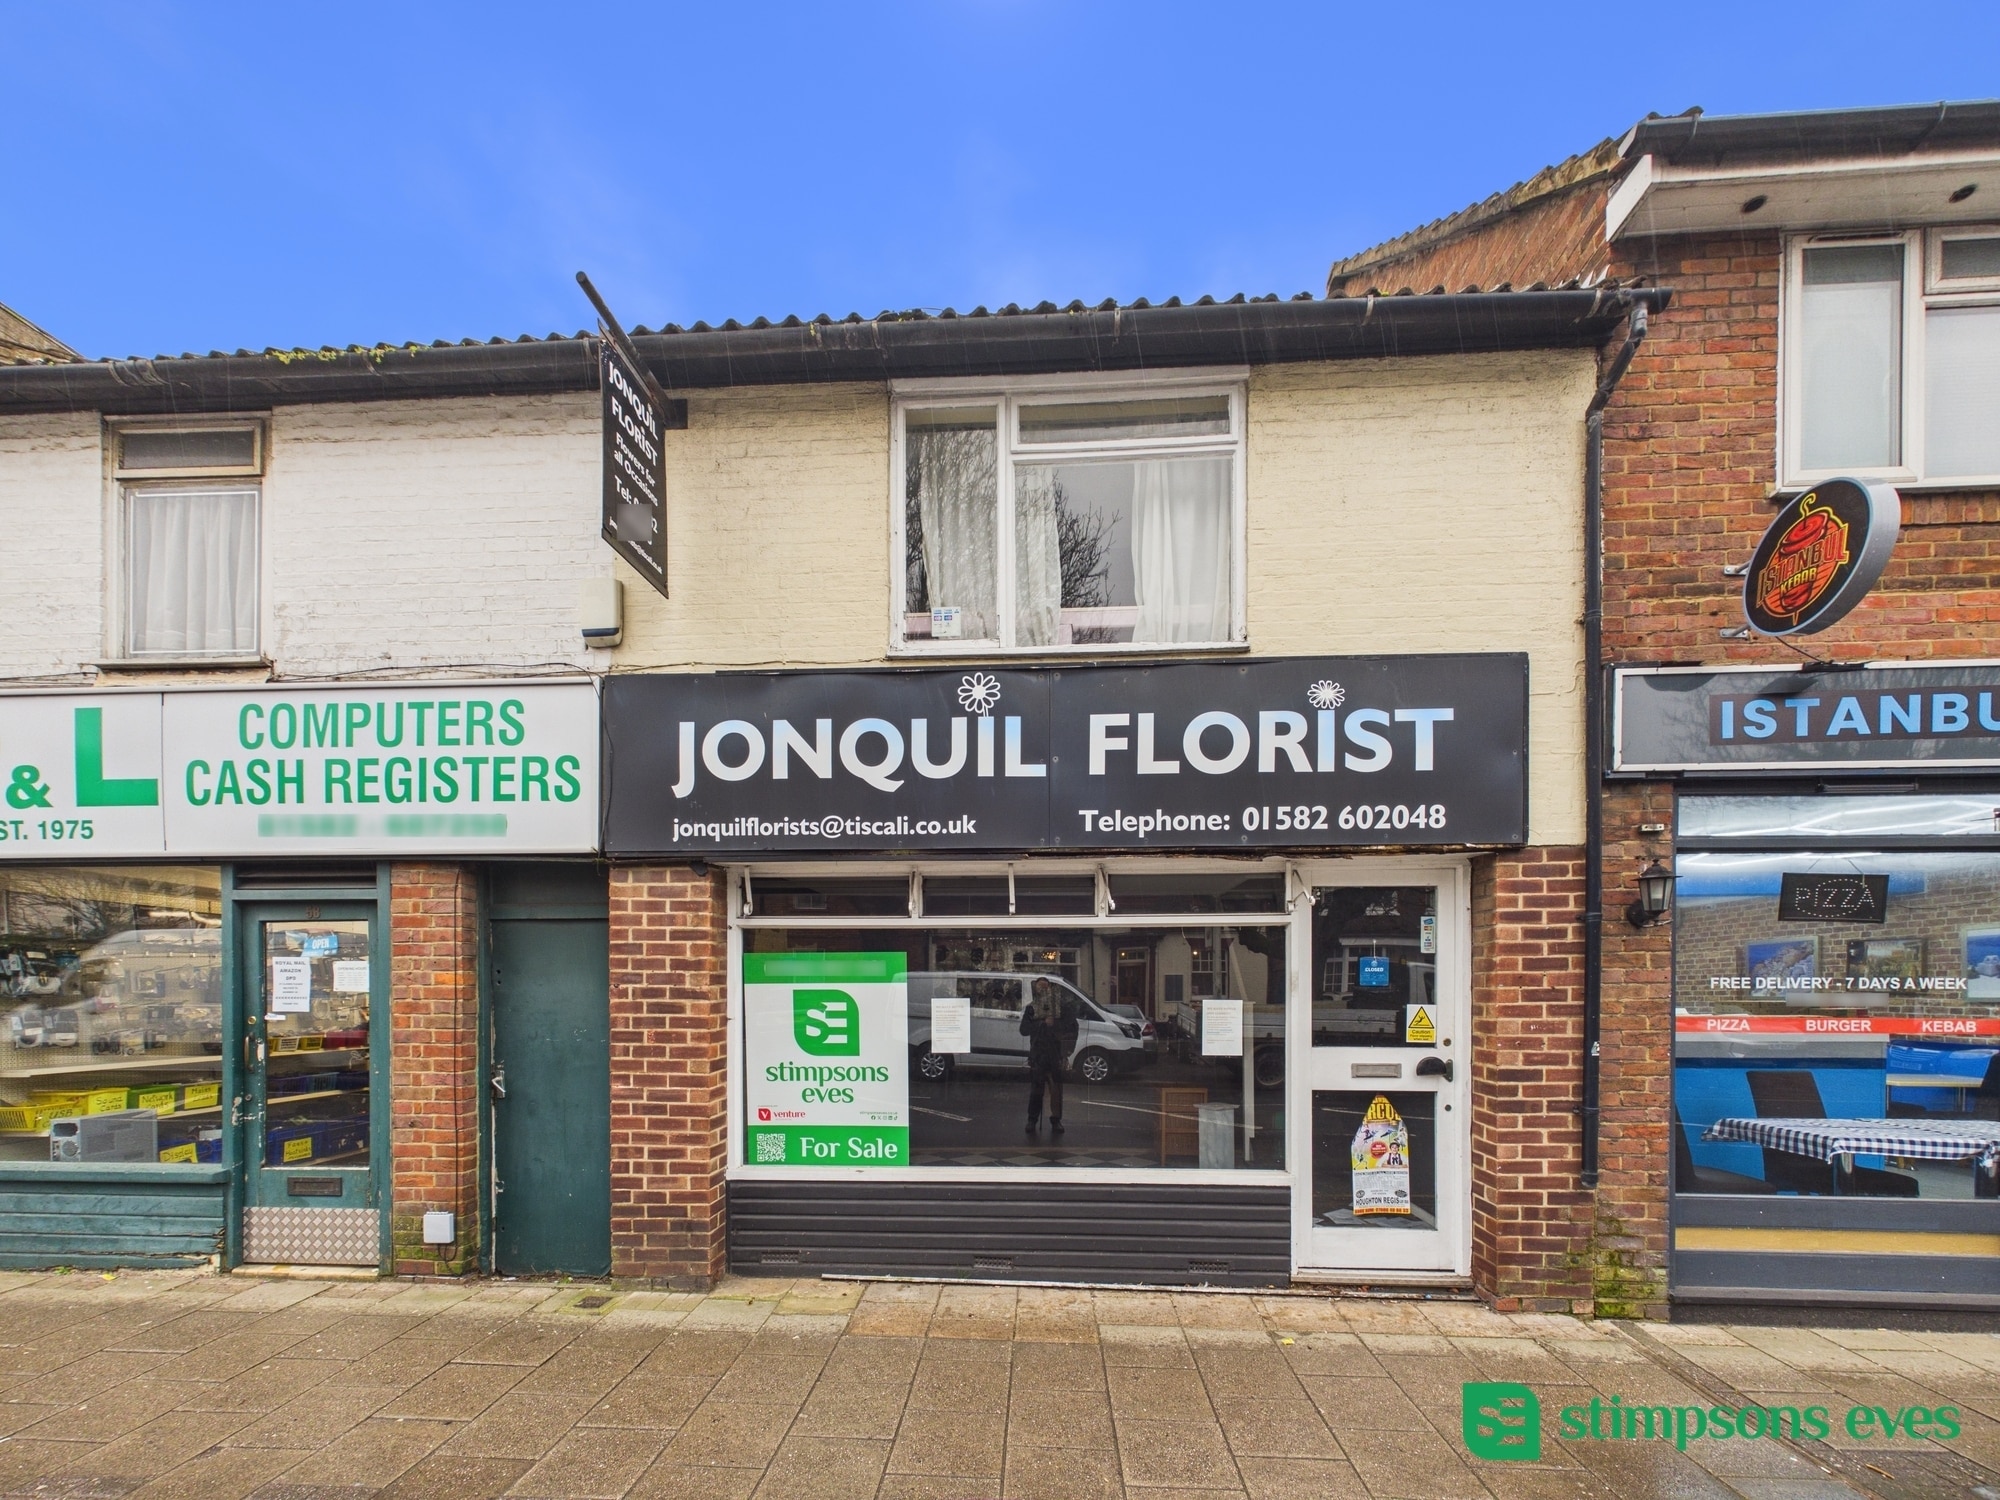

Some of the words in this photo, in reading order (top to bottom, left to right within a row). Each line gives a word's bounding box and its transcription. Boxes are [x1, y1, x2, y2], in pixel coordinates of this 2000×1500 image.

[609, 361, 658, 440] JONQUIL
[612, 396, 657, 466] FLORIST
[616, 432, 645, 475] Flowers
[613, 450, 623, 466] all
[624, 460, 658, 507] Occasions
[1756, 523, 1850, 608] ISTANBUL
[1780, 567, 1817, 595] KEBAB
[238, 699, 525, 750] COMPUTERS
[1089, 708, 1454, 775] FLORIST
[5, 764, 54, 810] &
[74, 707, 159, 807] L
[671, 715, 1047, 799] JONQUIL
[186, 758, 305, 806] CASH
[325, 754, 581, 804] REGISTERS
[38, 819, 94, 840] 1975
[672, 814, 977, 842] jonquilflorists@tiscali.co.uk
[1079, 809, 1231, 838] Telephone:
[1242, 806, 1329, 831] 01582
[1338, 804, 1447, 830] 602048
[1795, 887, 1875, 912] PIZZA
[312, 937, 330, 950] OPEN
[1711, 977, 1751, 989] FREE
[1756, 977, 1833, 989] DELIVERY
[1846, 977, 1853, 989] 7
[1858, 977, 1900, 989] DAYS
[1904, 977, 1915, 989] A
[1919, 977, 1967, 989] WEEK
[1707, 1019, 1750, 1031] PIZZA
[1806, 1020, 1872, 1032] BURGER
[1922, 1021, 1977, 1033] KEBAB
[766, 1061, 889, 1087] stimpsons
[801, 1087, 854, 1104] eves
[774, 1109, 806, 1118] venture
[800, 1137, 840, 1158] For
[848, 1137, 898, 1158] Sale
[1355, 1197, 1382, 1205] HOUGHTON
